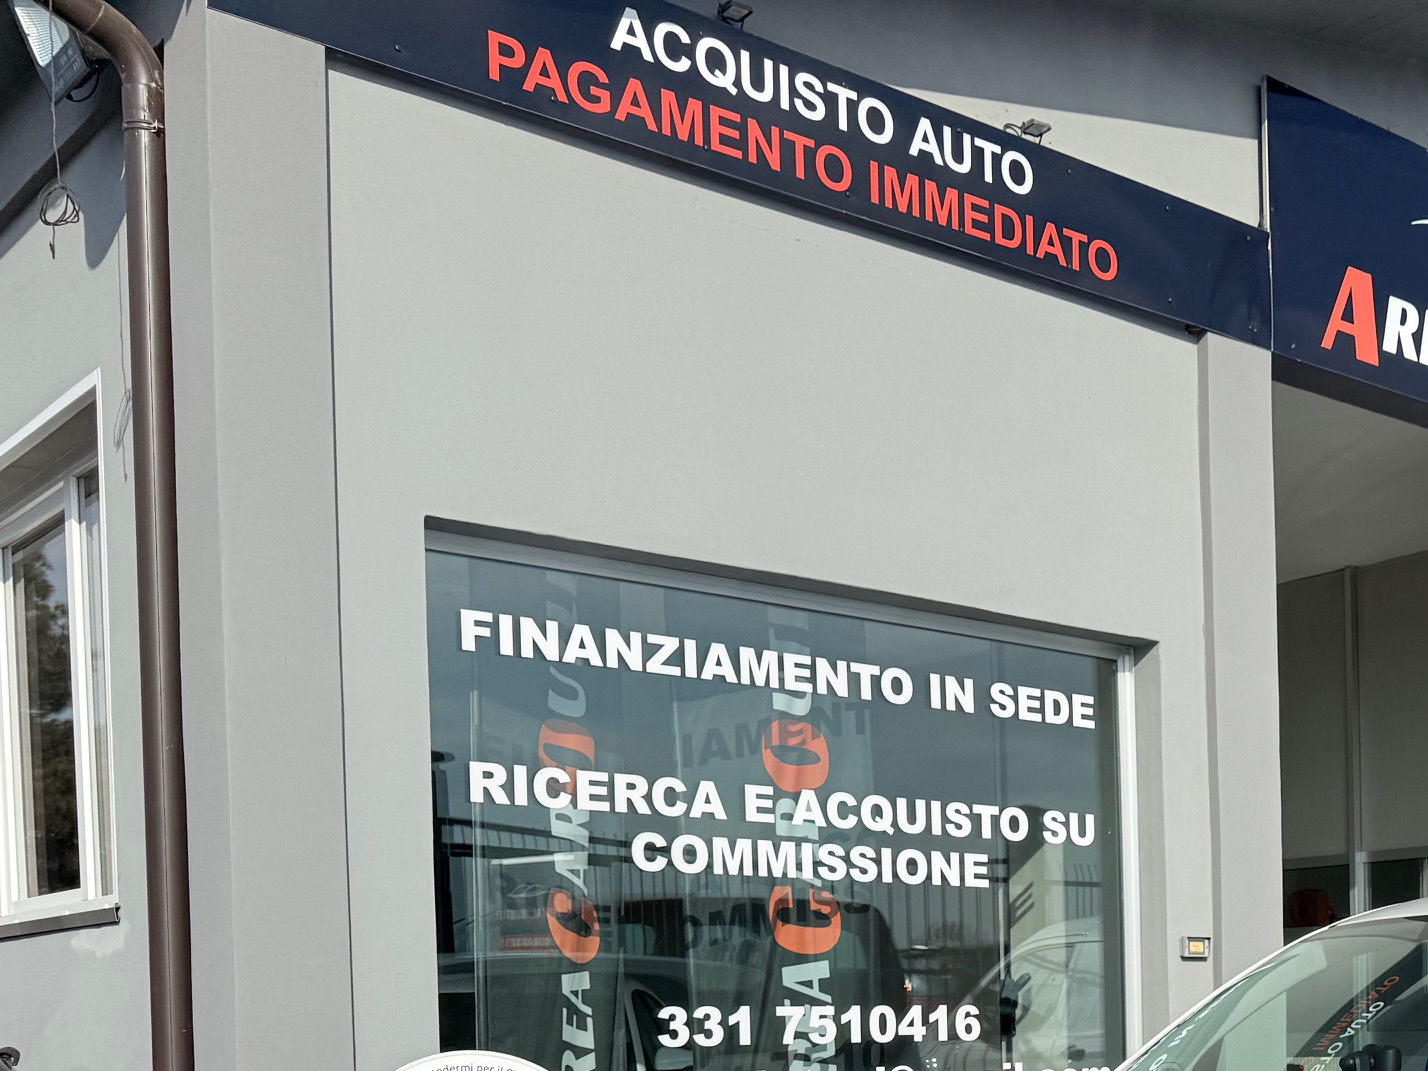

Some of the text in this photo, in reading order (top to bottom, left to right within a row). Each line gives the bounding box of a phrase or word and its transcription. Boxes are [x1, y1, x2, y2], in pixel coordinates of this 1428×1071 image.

[609, 7, 1034, 196] ACQUISTO AUTO
[487, 29, 1119, 283] PAGAMENTO IMMEDIATO
[459, 608, 1096, 730] FINANZIAMENTO IN SEDE
[468, 761, 1096, 847] RICERCA E ACQUISTO SU
[631, 831, 990, 889] COMMISSIONE
[657, 1004, 982, 1048] 331 7510416
